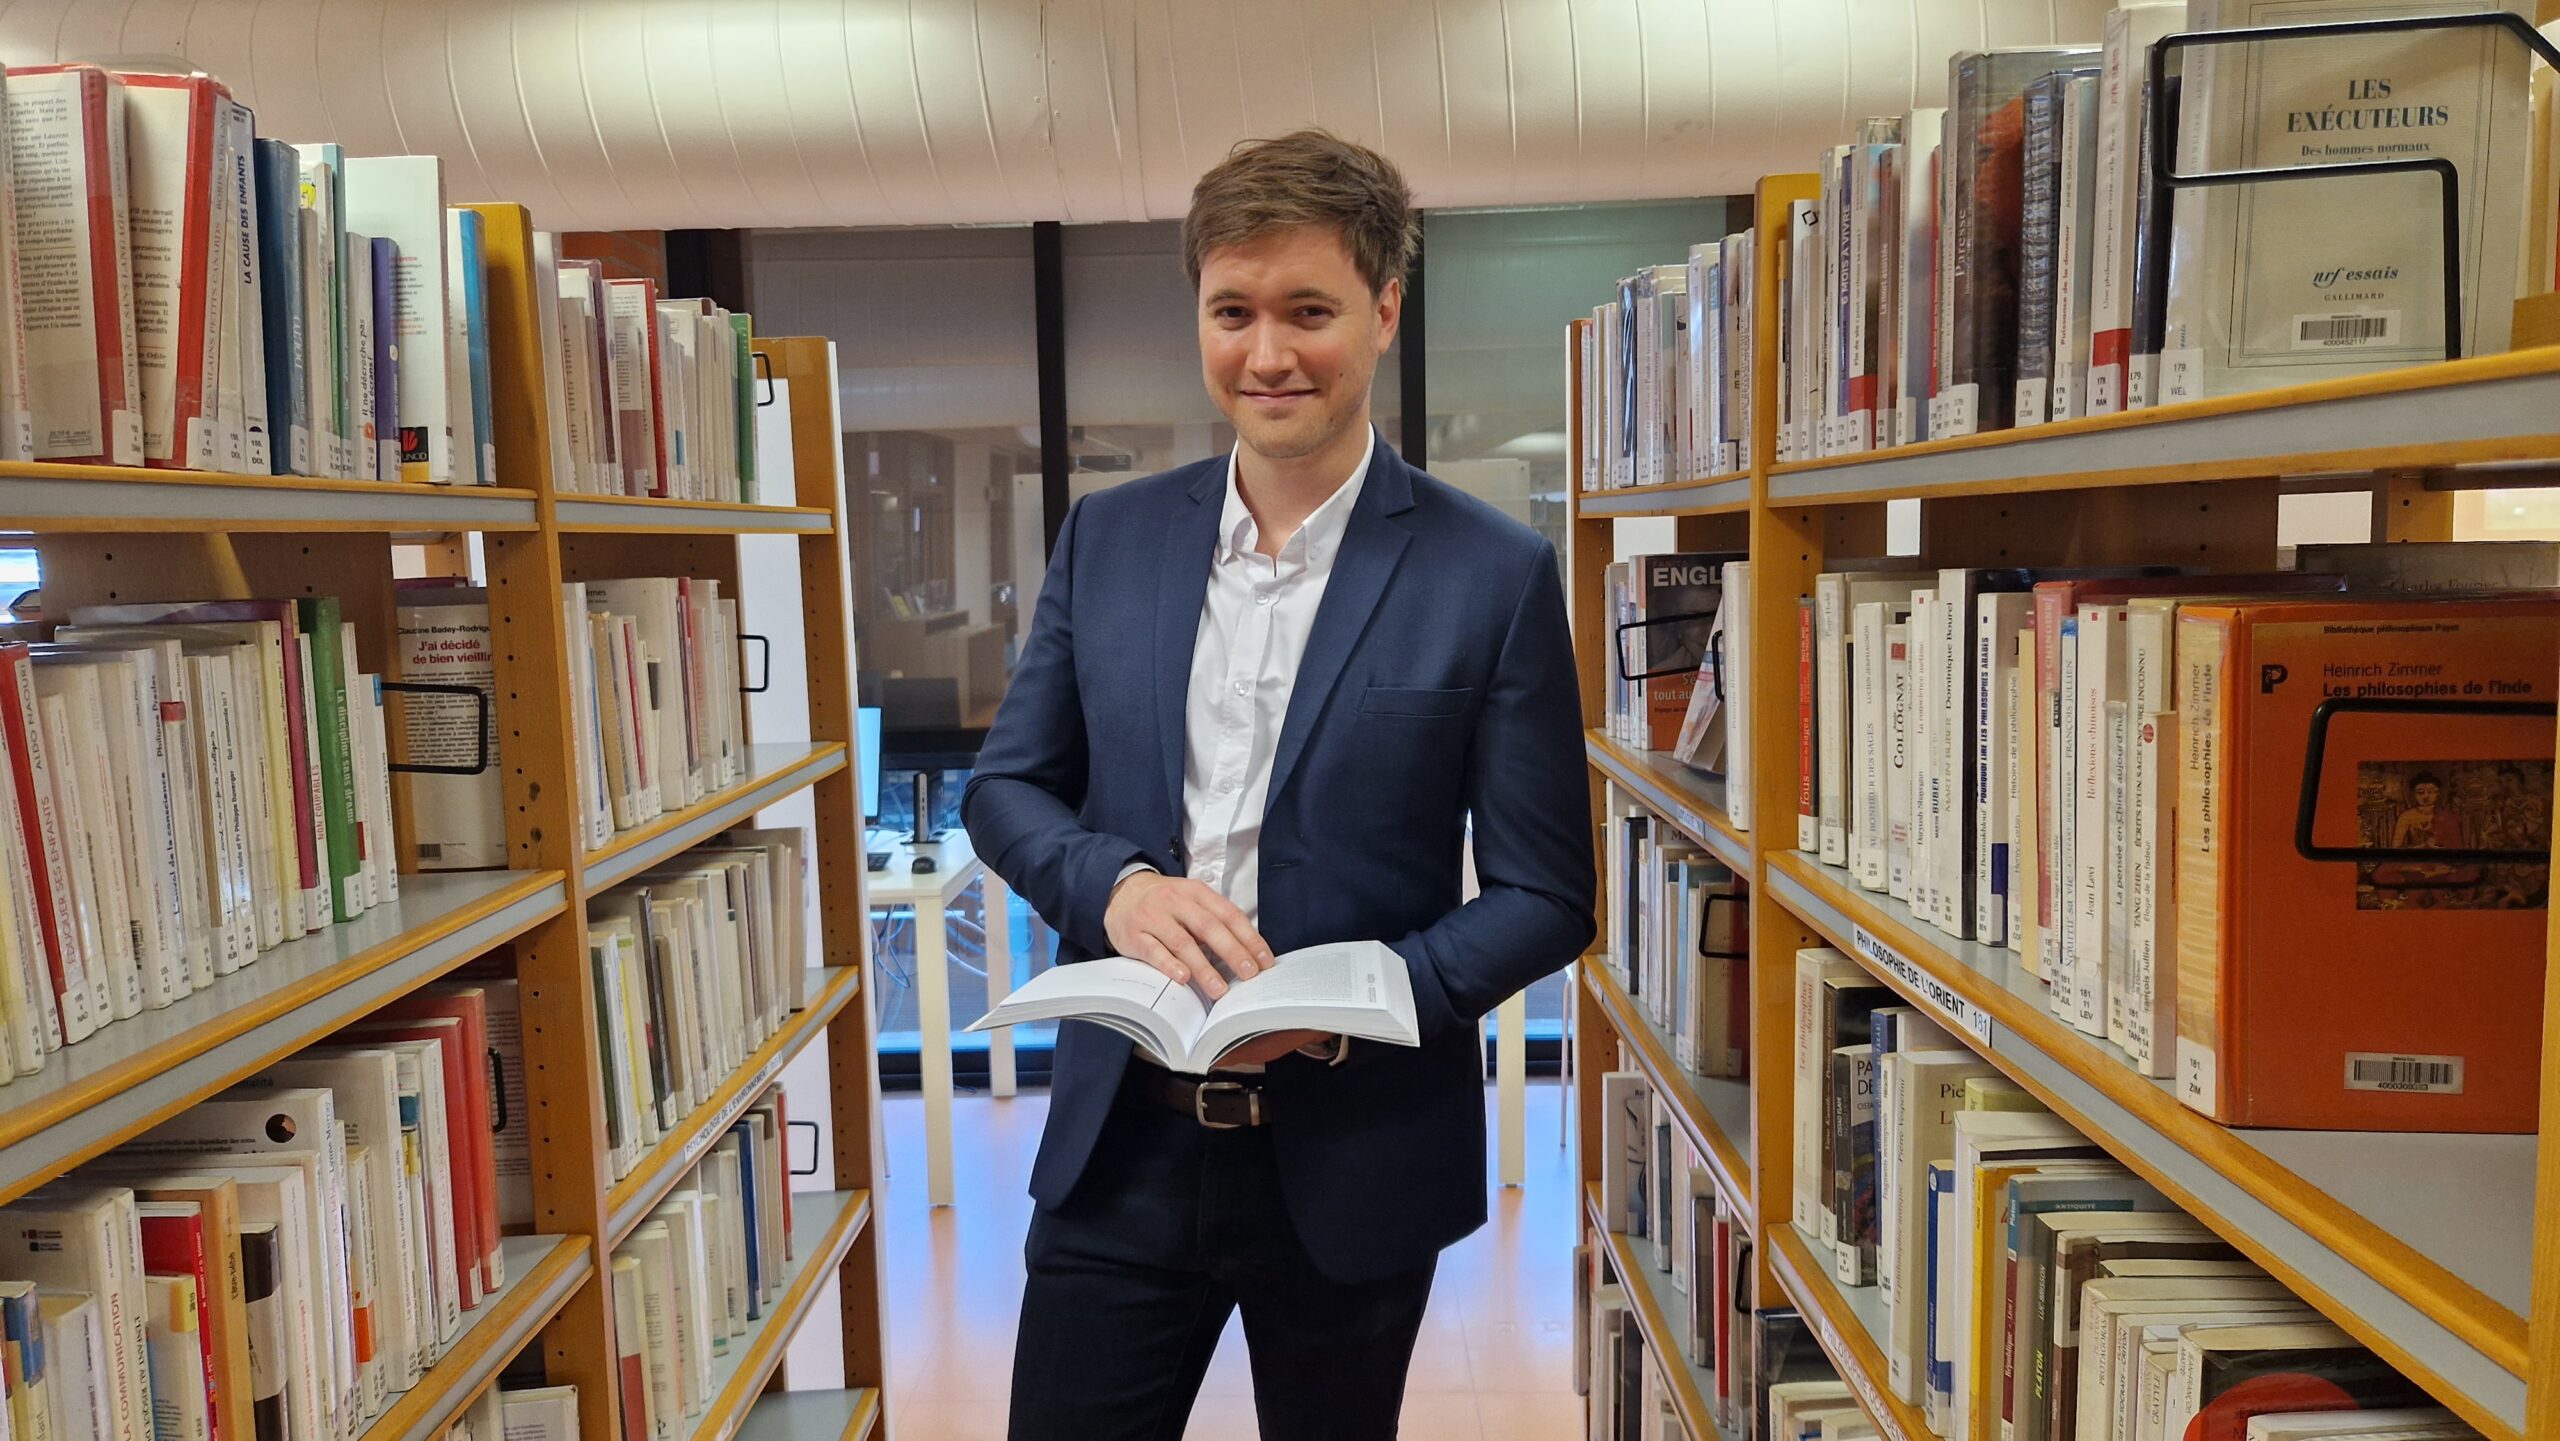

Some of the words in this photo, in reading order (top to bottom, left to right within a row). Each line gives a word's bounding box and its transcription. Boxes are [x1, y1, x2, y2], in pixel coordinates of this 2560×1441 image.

[2348, 79, 2392, 101] LES
[2287, 105, 2449, 134] EXÉCUTEURS
[2301, 144, 2322, 156] Des
[2325, 142, 2374, 155] hommes
[2377, 142, 2430, 153] normaux
[237, 155, 246, 205] ENFANTS
[239, 206, 248, 228] DES
[1840, 204, 1850, 242] VIVRE
[211, 222, 222, 284] CANARDS
[241, 232, 250, 267] CAUSE
[1953, 208, 1967, 277] Paresse
[243, 271, 252, 285] LA
[1840, 259, 1849, 293] MOIS
[2062, 280, 2068, 294] de
[2345, 266, 2399, 281] essais
[1841, 295, 1849, 304] 6
[1880, 280, 1888, 301] mort
[2324, 292, 2385, 302] GALLIMARD
[209, 290, 217, 334] PETITS
[359, 318, 367, 337] pas
[2060, 297, 2069, 346] Puissance
[206, 338, 216, 390] VILAINS
[359, 340, 367, 388] décroche
[2129, 371, 2143, 380] 179.
[2173, 363, 2186, 372] 179
[2129, 395, 2142, 404] VAN
[2133, 384, 2138, 392] 9
[2171, 387, 2187, 396] WEL
[1653, 566, 1725, 587] ENGL
[419, 641, 437, 651] J'ai
[440, 639, 480, 651] décidé
[2324, 625, 2375, 635] Bibliothèque
[2376, 624, 2433, 635] philosophique
[2435, 623, 2459, 634] Payot
[413, 654, 428, 664] de
[430, 653, 454, 664] bien
[456, 651, 493, 663] vieillir
[1863, 625, 1872, 675] JERPHAGNON
[1981, 637, 1989, 669] ARABES
[1945, 645, 1953, 709] Dominique
[2065, 660, 2073, 703] JULLIEN
[2137, 648, 2147, 700] INCONNU
[2201, 664, 2213, 703] l'Inde
[2261, 664, 2288, 694] P
[2324, 663, 2382, 678] Heinrich
[2387, 662, 2443, 677] Zimmer
[19, 664, 36, 724] NAOURI
[336, 689, 345, 703] La
[1654, 689, 1676, 700] tout
[2189, 664, 2200, 712] Zimmer
[2323, 683, 2350, 697] Les
[2357, 681, 2457, 698] philosophies
[2463, 680, 2483, 695] de
[2489, 680, 2532, 694] l'Inde
[2009, 676, 2018, 733] philosophie
[2088, 688, 2097, 740] chinoises
[2202, 708, 2212, 726] de
[154, 715, 164, 758] Philippe
[223, 709, 231, 747] commande
[337, 706, 350, 757] discipline
[1802, 717, 1811, 746] sages
[1893, 673, 1905, 769] COLLOGNAT
[1980, 728, 1988, 742] LES
[2065, 706, 2075, 758] FRANÇOIS
[30, 730, 43, 770] ALDO
[1866, 723, 1875, 755] SAGES
[1980, 744, 1988, 760] LIRE
[2010, 735, 2017, 744] la
[2010, 745, 2017, 760] de
[2114, 711, 2125, 781] aujourd'hui
[2189, 717, 2200, 770] Heinrich
[343, 760, 352, 786] sans
[1867, 757, 1875, 778] DES
[1980, 763, 1988, 804] POURQUOI
[2010, 762, 2018, 799] Histoire
[2086, 745, 2097, 800] Réflexions
[2201, 732, 2213, 822] philosophies
[160, 771, 172, 836] conscience
[312, 764, 323, 817] COUPABLES
[345, 788, 355, 825] drame
[1800, 775, 1810, 806] fous
[1931, 778, 1939, 814] BUBER
[2114, 785, 2123, 822] Chine
[2134, 780, 2143, 808] D'UN
[1868, 781, 1877, 833] BONHEUR
[41, 795, 59, 862] ENFANTS
[316, 821, 325, 840] NON
[1917, 811, 1925, 846] Daryush
[2116, 827, 2123, 842] en
[2133, 810, 2143, 848] ÉCRITS
[2201, 828, 2211, 853] Les
[168, 853, 175, 868] de
[2114, 845, 2125, 889] pensée
[2143, 840, 2151, 870] fadeur
[52, 866, 63, 892] SES
[2064, 875, 2074, 897] vie
[2086, 866, 2095, 889] Levi
[2143, 884, 2150, 895] de
[2066, 899, 2074, 914] sa
[2086, 893, 2096, 919] Jean
[2115, 892, 2124, 905] La
[2134, 898, 2142, 928] TANG
[2142, 940, 2150, 973] Jullien
[1857, 930, 1906, 979] PHILOSOPHIE
[1908, 970, 1919, 985] DE
[1922, 978, 1965, 1018] L'ORIENT
[1973, 1011, 1988, 1036] 181
[2061, 986, 2071, 995] 114
[1799, 980, 1809, 1049] philosophes
[2061, 996, 2072, 1007] JUL
[2080, 1010, 2093, 1020] LEV
[2083, 1000, 2090, 1009] 11
[2190, 1058, 2201, 1069] 181
[2192, 1073, 2198, 1082] 4
[2189, 1083, 2201, 1095] ZIM
[323, 1100, 333, 1140] Murray
[686, 1117, 721, 1154] PSYCHOLOGIE
[326, 1142, 336, 1174] Lynne
[1897, 1130, 1905, 1164] Pierre
[2009, 1199, 2017, 1227] Platon
[2038, 1264, 2046, 1302] BRISSON
[110, 1292, 129, 1420] COMMUNICATION
[134, 1316, 145, 1366] L'ENFANT
[2004, 1332, 2014, 1378] République
[2098, 1319, 2107, 1386] PROTAGORAS
[2120, 1330, 2128, 1365] CRITON
[139, 1369, 146, 1384] AU
[2034, 1349, 2045, 1399] PLATON
[2119, 1373, 2127, 1414] SOCRATE
[2152, 1374, 2161, 1425] CRATYLE
